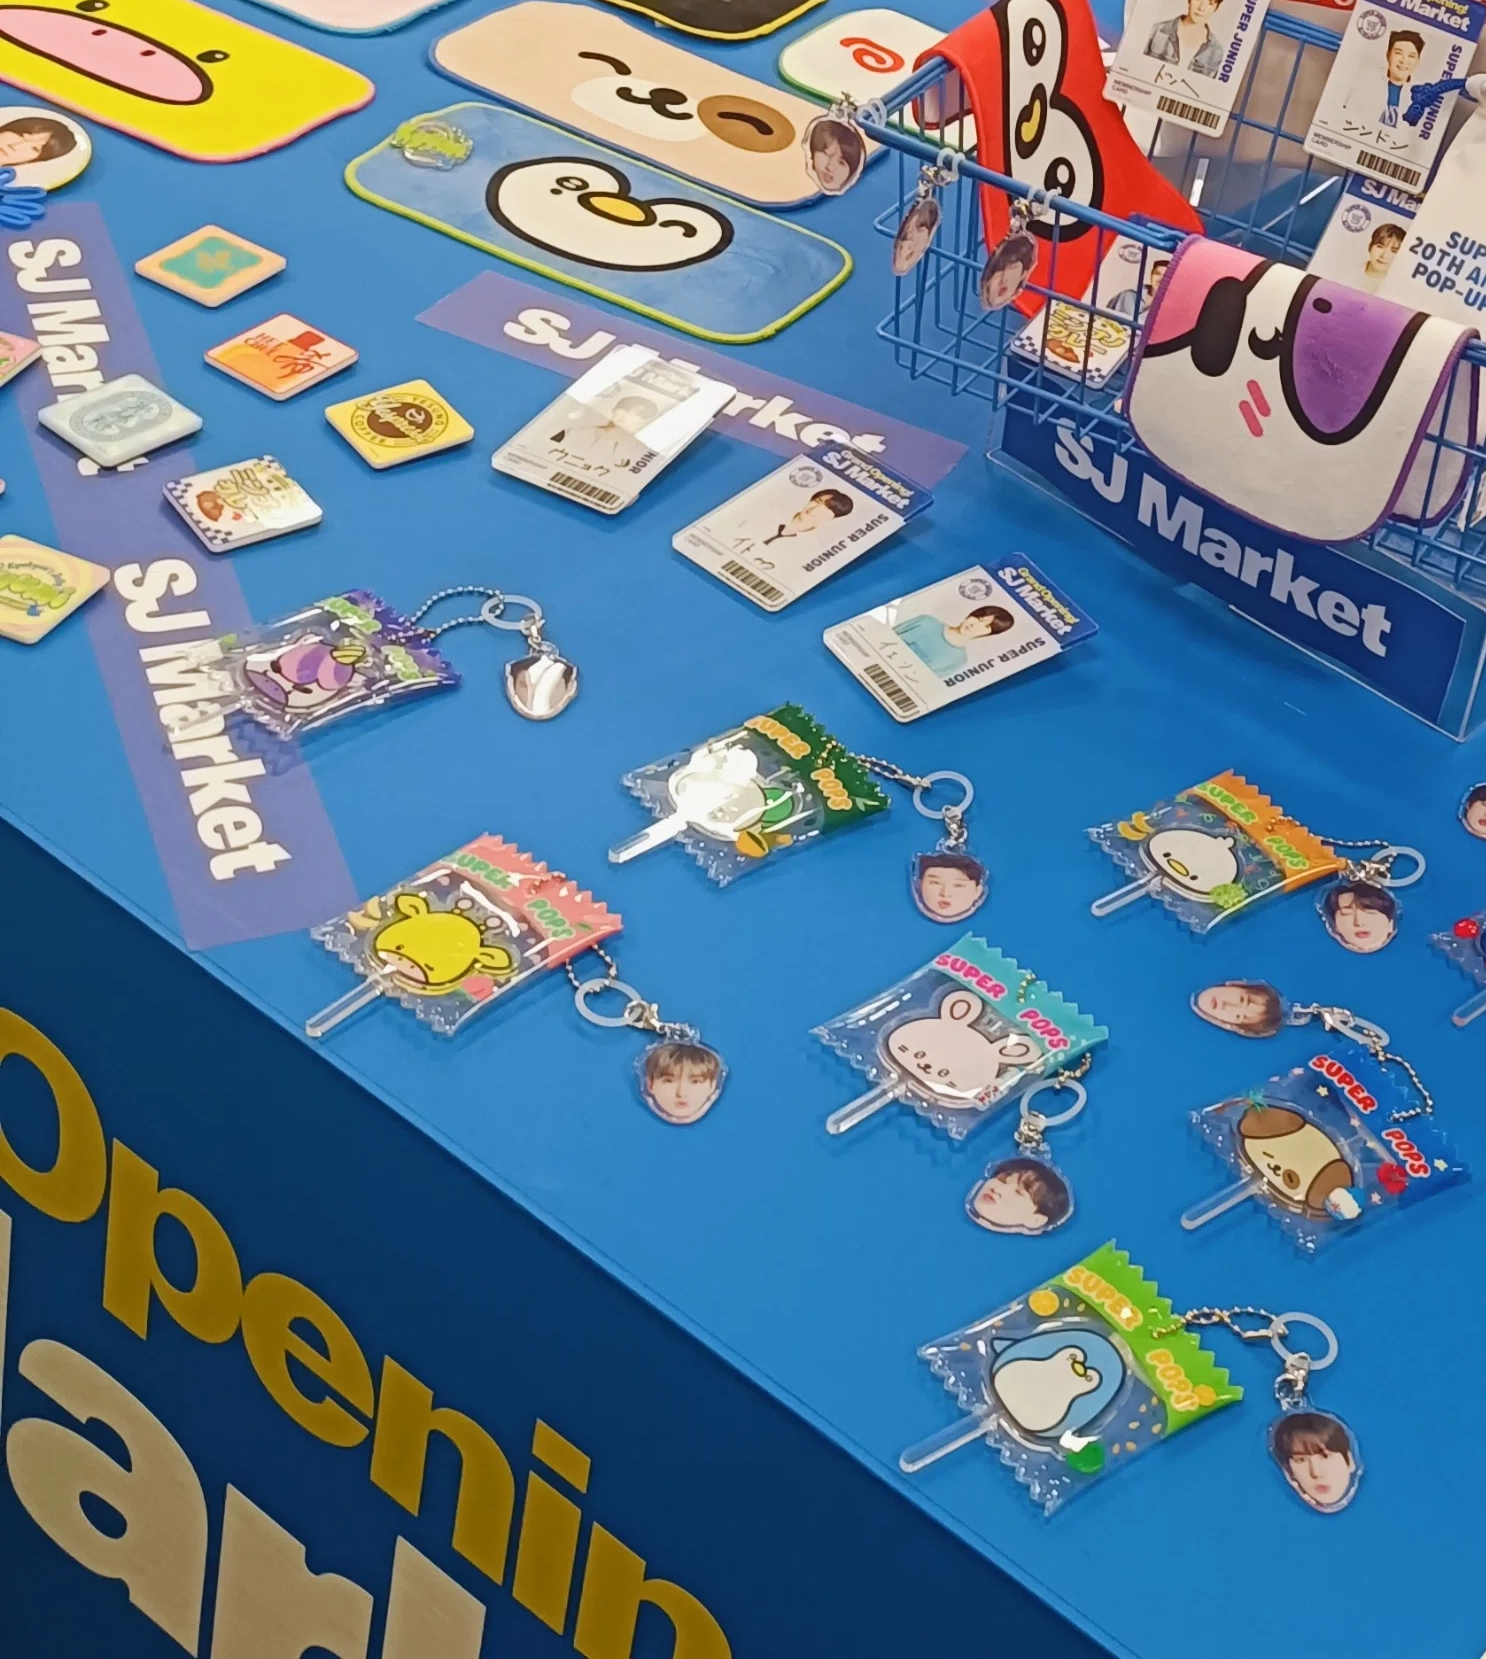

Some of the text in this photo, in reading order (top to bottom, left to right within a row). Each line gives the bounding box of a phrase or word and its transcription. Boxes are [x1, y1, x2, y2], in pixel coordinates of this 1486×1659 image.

[1217, 32, 1244, 84] JUNIOR
[1418, 43, 1463, 141] SUPE UNIOR
[1360, 178, 1388, 200] SJ
[8, 237, 93, 294] SJ
[1408, 236, 1466, 277] 20TH
[503, 307, 618, 361] SJ
[628, 449, 660, 476] NIOR
[822, 450, 911, 510] SJ Market
[801, 538, 848, 574] JUNIOR
[846, 513, 891, 544] SUPER
[1053, 417, 1393, 658] SJ Market
[113, 557, 213, 634] SJ
[998, 565, 1074, 637] SJ Market
[1017, 566, 1081, 628] Grand Opening!
[942, 636, 1047, 689] SUPER JUNIOR
[138, 636, 293, 882] Market
[744, 714, 853, 812] SUPER POPS
[1197, 781, 1310, 872] SUPER POPS
[523, 898, 578, 941] POPS
[934, 952, 1009, 1002] SUPER
[1018, 1008, 1071, 1052] POPS
[1308, 1054, 1431, 1179] SUPER POPS
[1063, 1265, 1201, 1414] SUPER POPS
